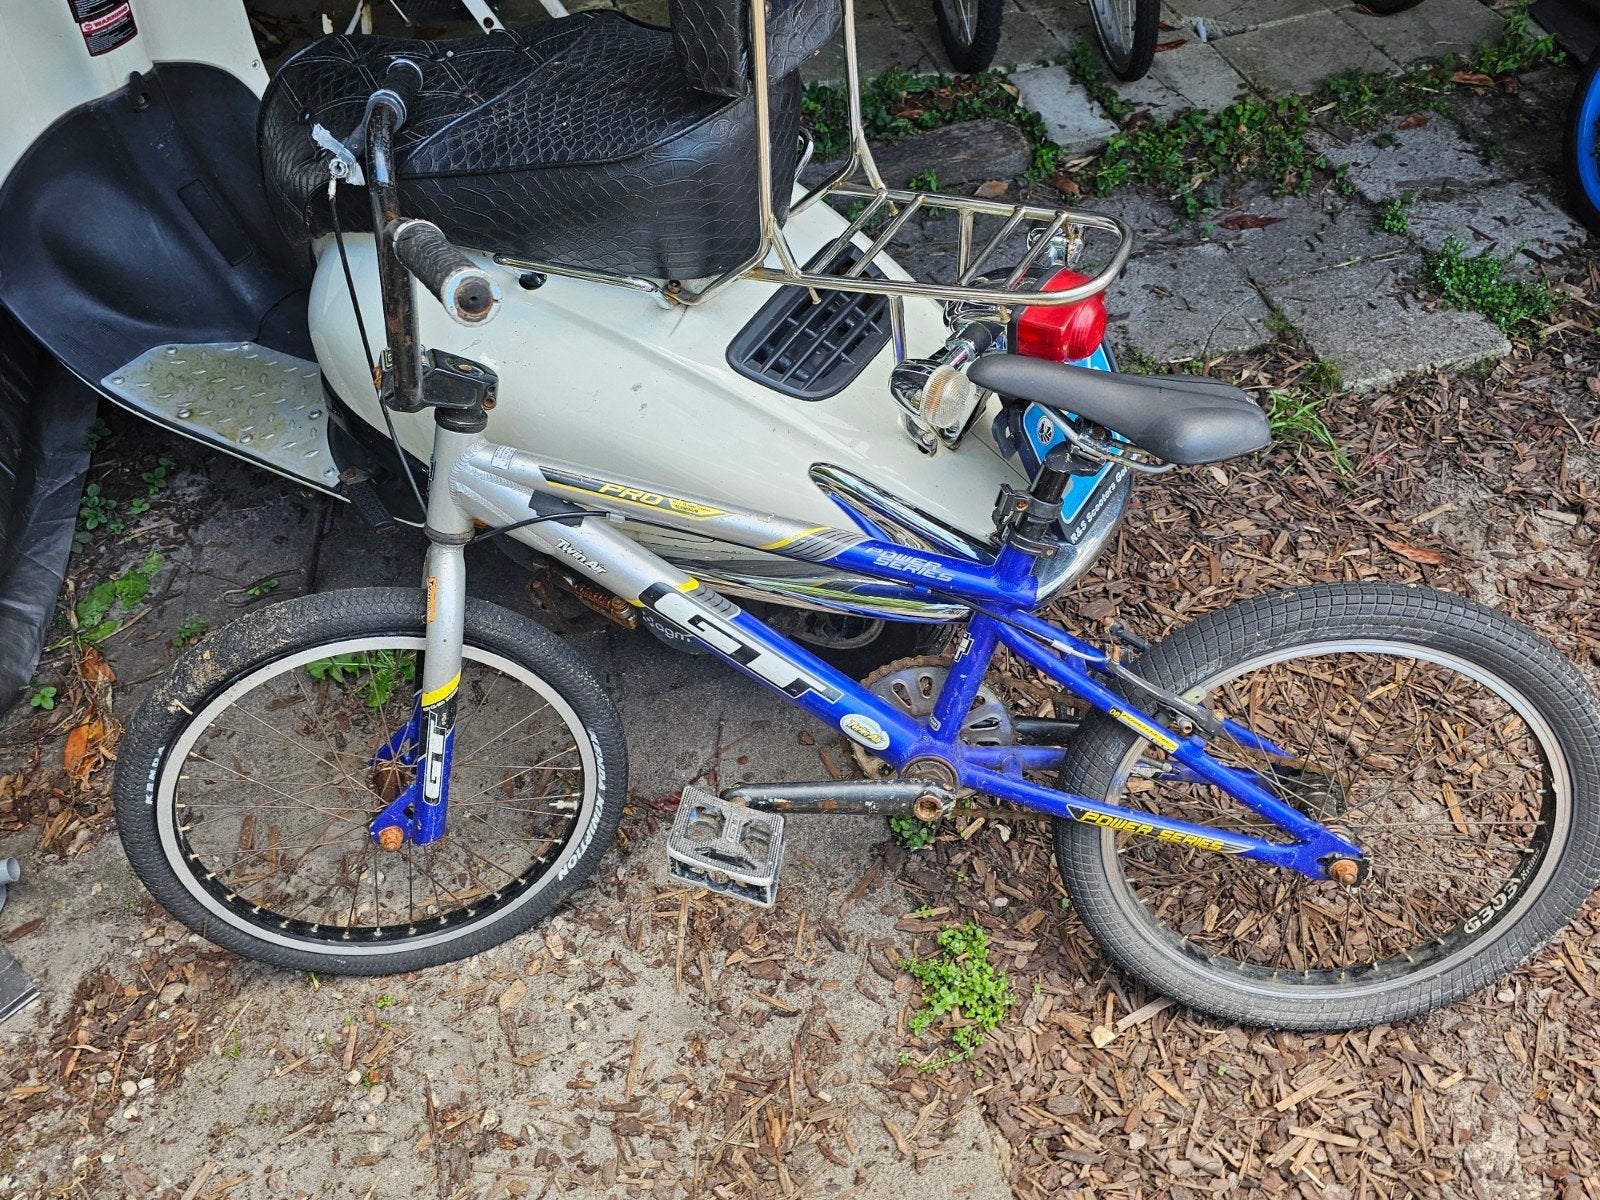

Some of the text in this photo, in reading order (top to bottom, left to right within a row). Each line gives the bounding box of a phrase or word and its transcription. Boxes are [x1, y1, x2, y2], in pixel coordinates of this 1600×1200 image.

[94, 6, 127, 27] WARNING
[598, 482, 664, 506] PRO
[1070, 520, 1087, 544] R&S
[1086, 482, 1116, 522] Scooters
[556, 537, 587, 564] Twin
[864, 547, 942, 569] POWER
[873, 556, 957, 582] SERIES
[847, 719, 870, 738] Twin
[1080, 811, 1225, 852] POWER SERIES
